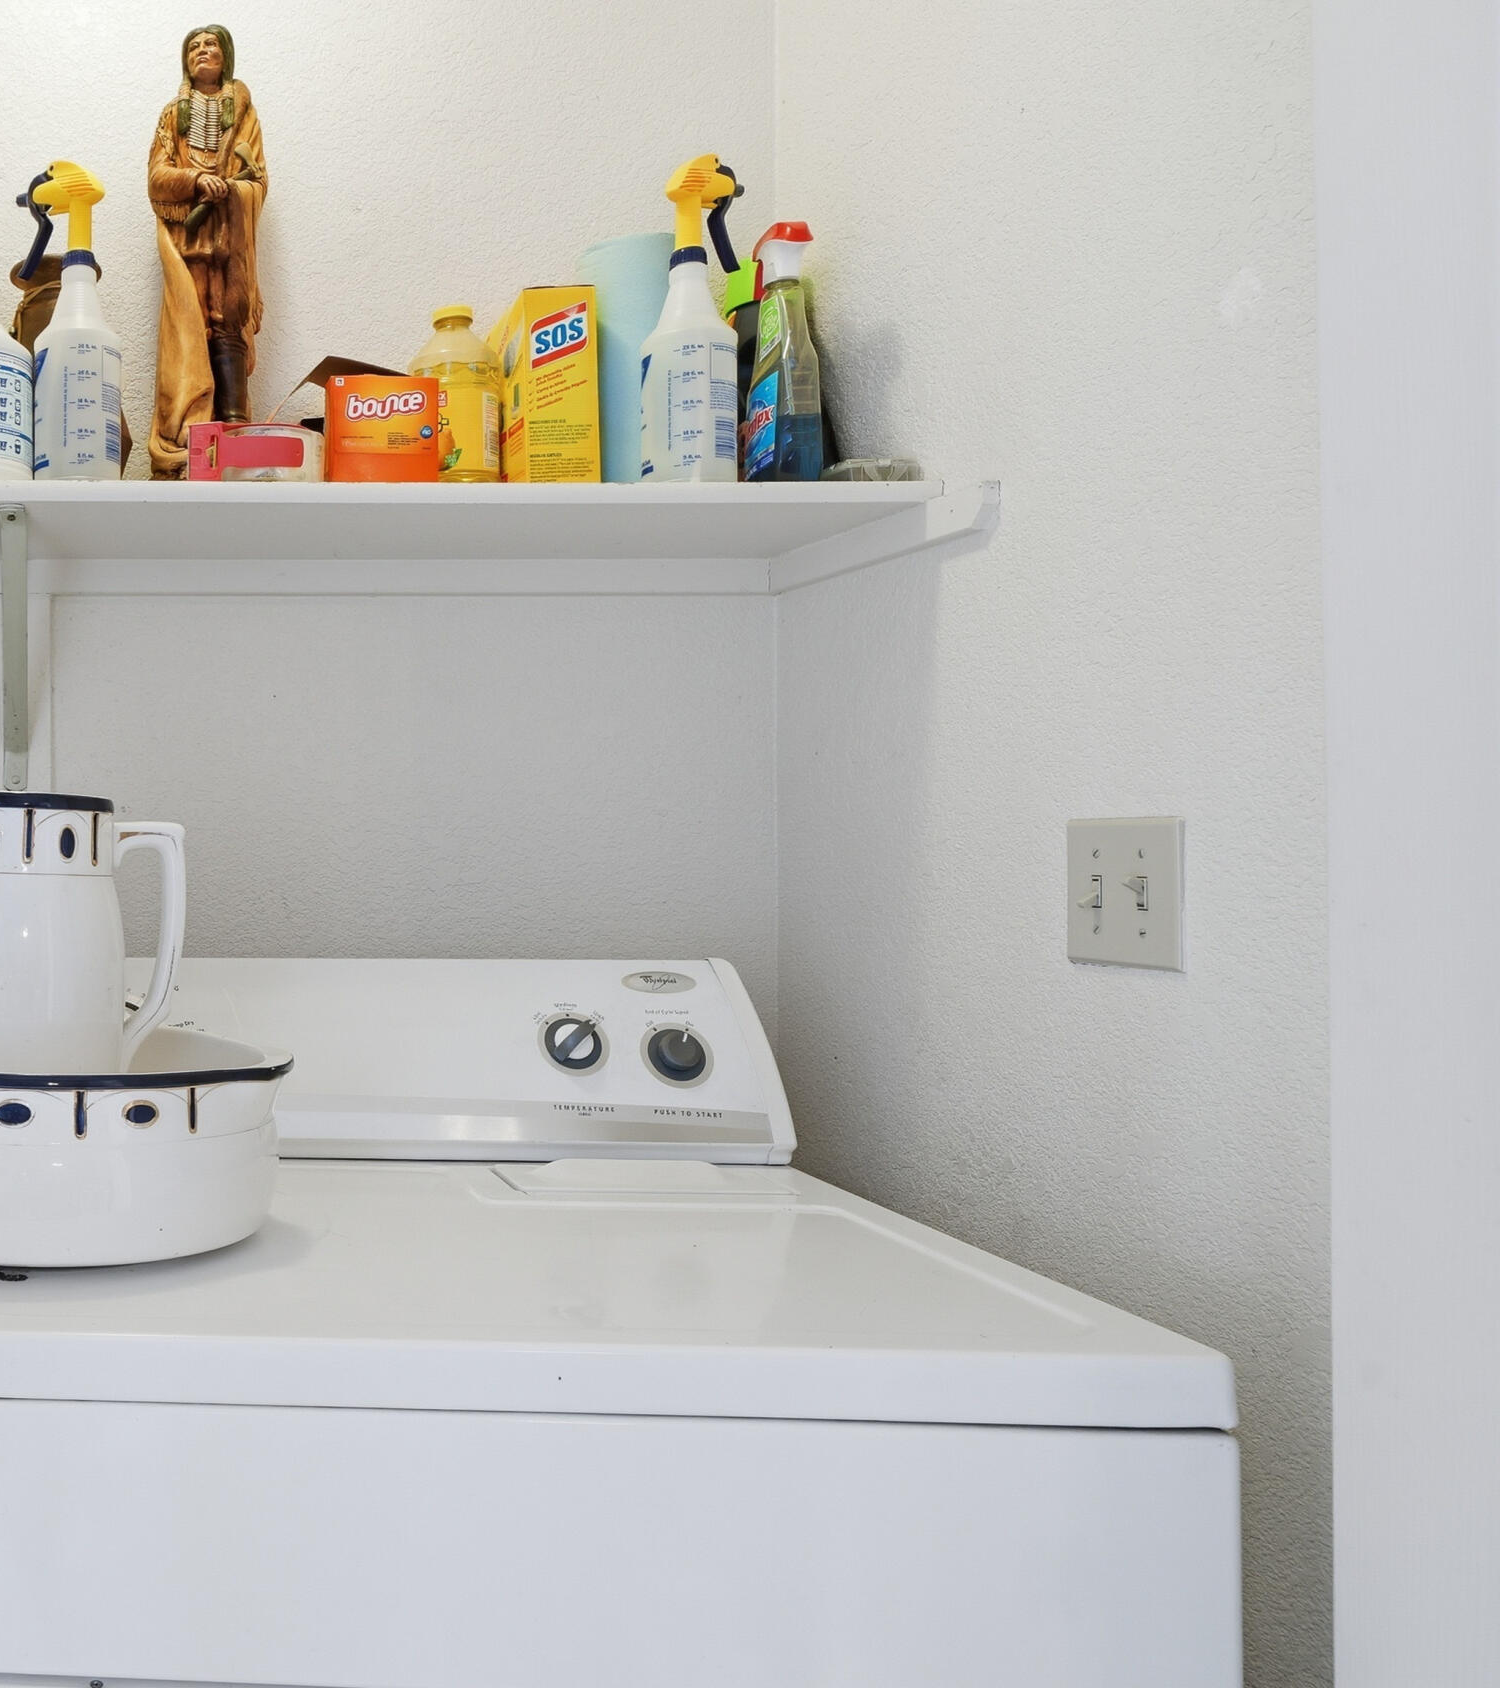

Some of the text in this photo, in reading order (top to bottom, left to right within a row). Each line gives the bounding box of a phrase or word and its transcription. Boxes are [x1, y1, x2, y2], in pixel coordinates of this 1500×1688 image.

[347, 391, 426, 421] bounce
[553, 1104, 615, 1113] TEMPERATURE
[696, 1111, 723, 1119] START
